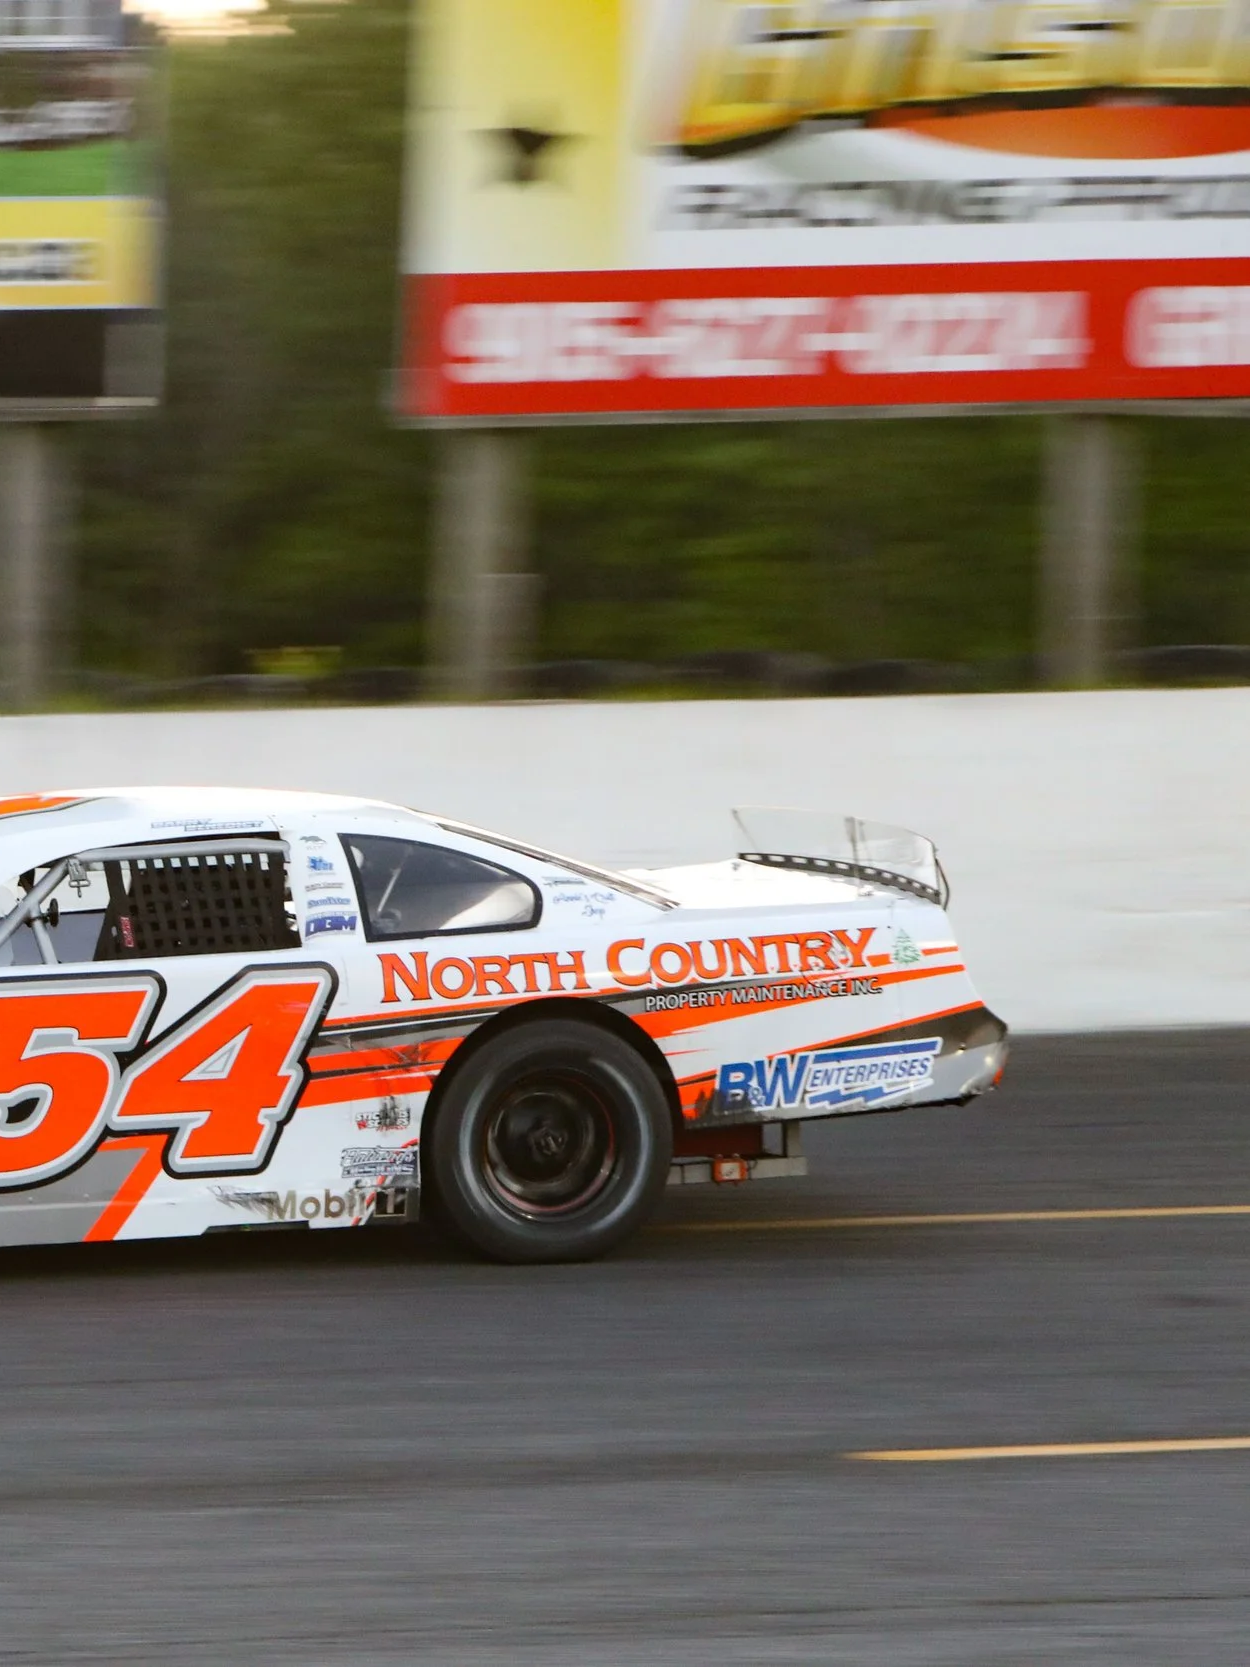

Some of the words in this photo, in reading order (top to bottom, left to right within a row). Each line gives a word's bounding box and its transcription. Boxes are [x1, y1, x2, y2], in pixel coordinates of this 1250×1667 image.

[377, 950, 593, 1004] NORTH
[607, 927, 877, 985] COUNTRY
[645, 989, 732, 1012] PROPERTY
[732, 978, 846, 1004] MAINTENANCE
[851, 977, 883, 995] INC.
[717, 1055, 809, 1109] B&W
[810, 1057, 930, 1088] ENTERPRISES
